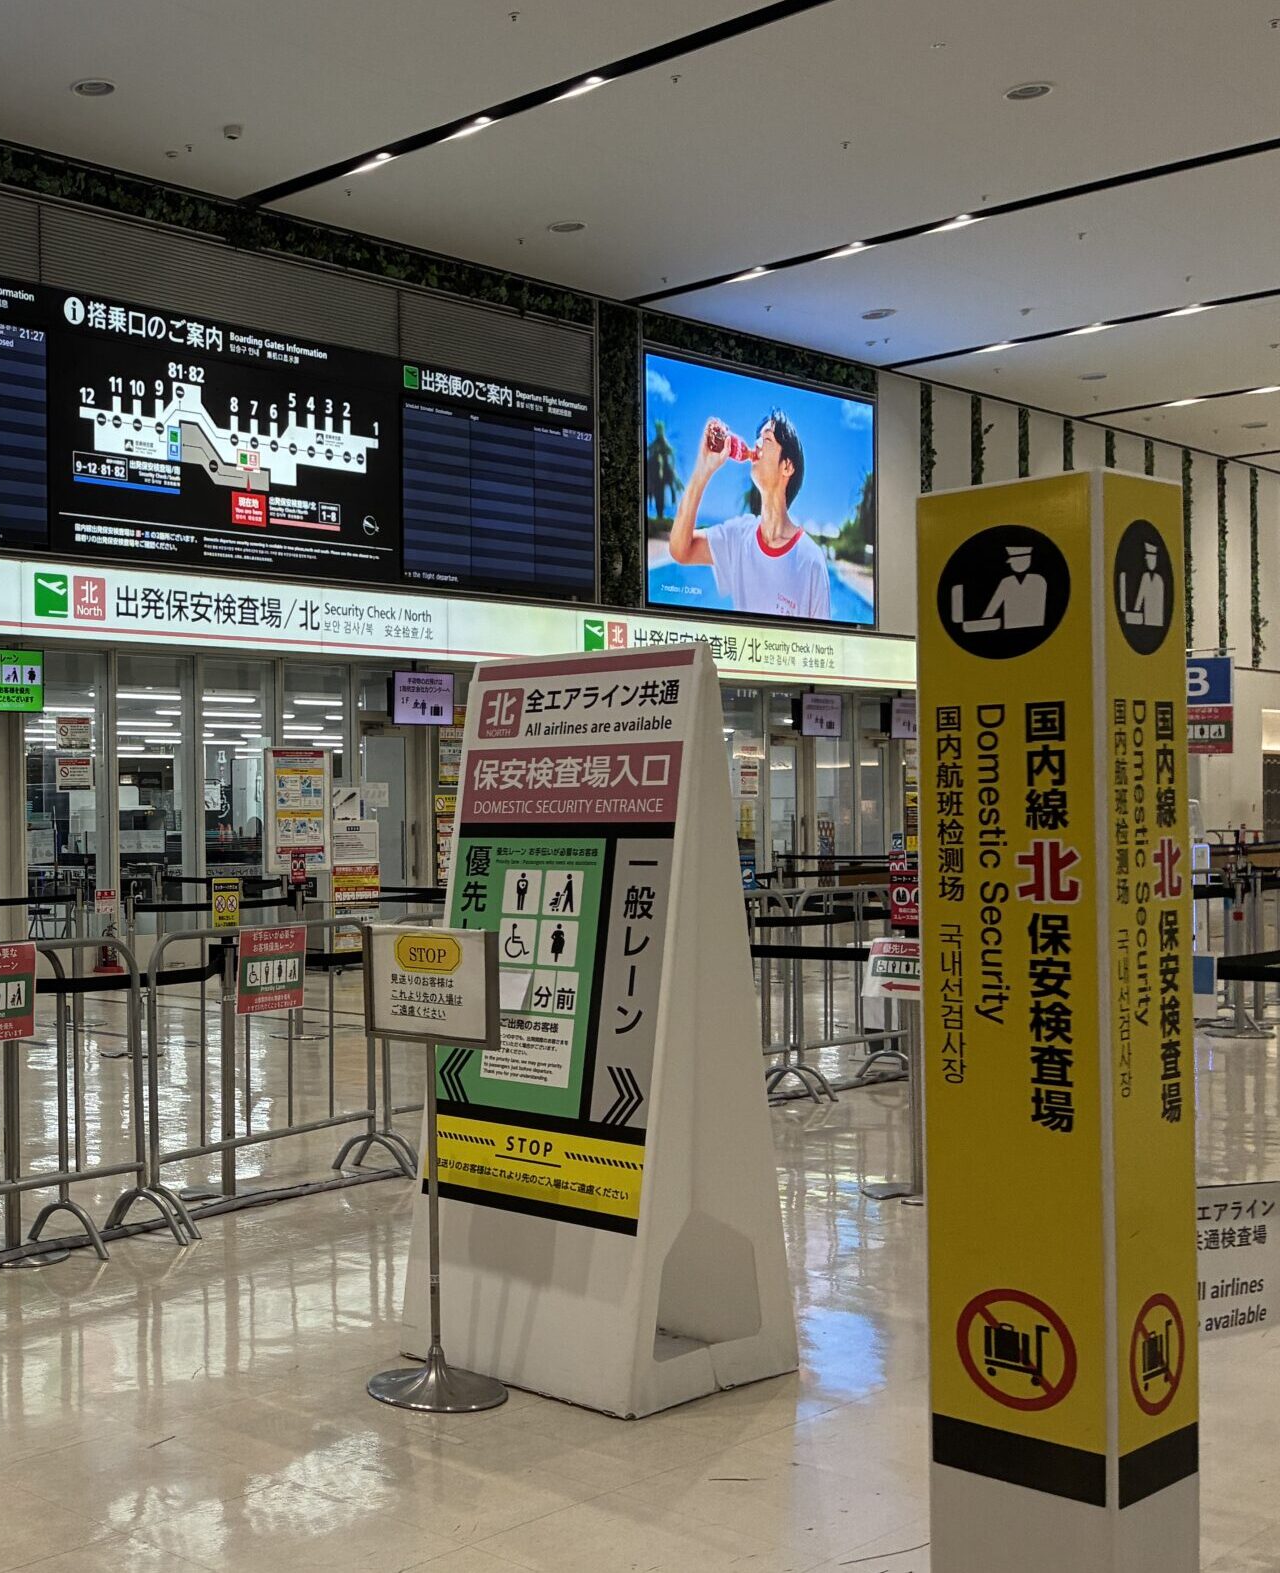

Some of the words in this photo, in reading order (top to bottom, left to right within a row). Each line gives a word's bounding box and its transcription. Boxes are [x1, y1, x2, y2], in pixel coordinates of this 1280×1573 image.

[19, 328, 45, 342] 21:27
[88, 300, 223, 352] 搭乗口のご案内
[230, 331, 263, 348] Boarding
[264, 339, 285, 351] Gates
[286, 343, 328, 360] Information
[109, 376, 123, 393] 11
[129, 380, 145, 397] 10
[154, 380, 164, 396] 9
[421, 370, 513, 407] 出発便のご案内
[80, 388, 95, 405] 12
[230, 397, 238, 412] 8
[289, 393, 296, 408] 5
[306, 396, 315, 411] 4
[516, 390, 543, 402] Departure
[543, 395, 557, 406] Flight
[558, 398, 588, 411] Information
[250, 400, 258, 415] 7
[270, 404, 278, 420] 6
[325, 399, 333, 414] 3
[342, 402, 350, 417] 2
[373, 422, 379, 436] 1
[321, 511, 337, 522] 1-8
[80, 580, 99, 604] 北
[76, 604, 103, 617] North
[116, 585, 320, 632] 出発保安検査場/北
[324, 602, 365, 621] Security
[366, 604, 396, 621] Check
[404, 608, 432, 624] North
[323, 620, 341, 633] 보안
[385, 625, 434, 641] 安全检查/北
[612, 626, 624, 644] 北
[764, 640, 790, 655] Security
[791, 642, 810, 654] Check
[815, 644, 834, 656] North
[1187, 666, 1210, 697] B
[525, 679, 680, 714] 全エアライン共通
[486, 692, 517, 727] 北
[485, 729, 512, 738] NORTH
[525, 722, 541, 737] All
[543, 719, 588, 736] airlines
[590, 721, 611, 734] are
[613, 715, 672, 732] available
[473, 754, 671, 791] 保安検査場入口
[976, 704, 1008, 869] Domestic
[1132, 701, 1146, 868] Domestic
[473, 800, 533, 814] DOMESTIC
[535, 799, 592, 814] SECURITY
[595, 798, 664, 813] ENTRANCE
[935, 705, 965, 902] 国内航班检测场
[1017, 701, 1081, 1133] 国内線北保安検査場
[1153, 701, 1183, 1123] 国内線北保安検査場
[409, 946, 447, 964] STOP
[615, 859, 659, 1035] 一般レーン
[975, 881, 1009, 1025] Security
[1134, 880, 1150, 1026] Security
[390, 973, 454, 989] 見送りのお客様は
[391, 989, 463, 1006] これより先の入場は
[938, 923, 966, 1084] 국내선검사장
[391, 1004, 447, 1020] ご遠慮ください
[506, 1135, 554, 1158] STOP
[1198, 1199, 1275, 1222] エアライン
[1210, 1276, 1264, 1299] airlines
[1205, 1304, 1267, 1332] available
